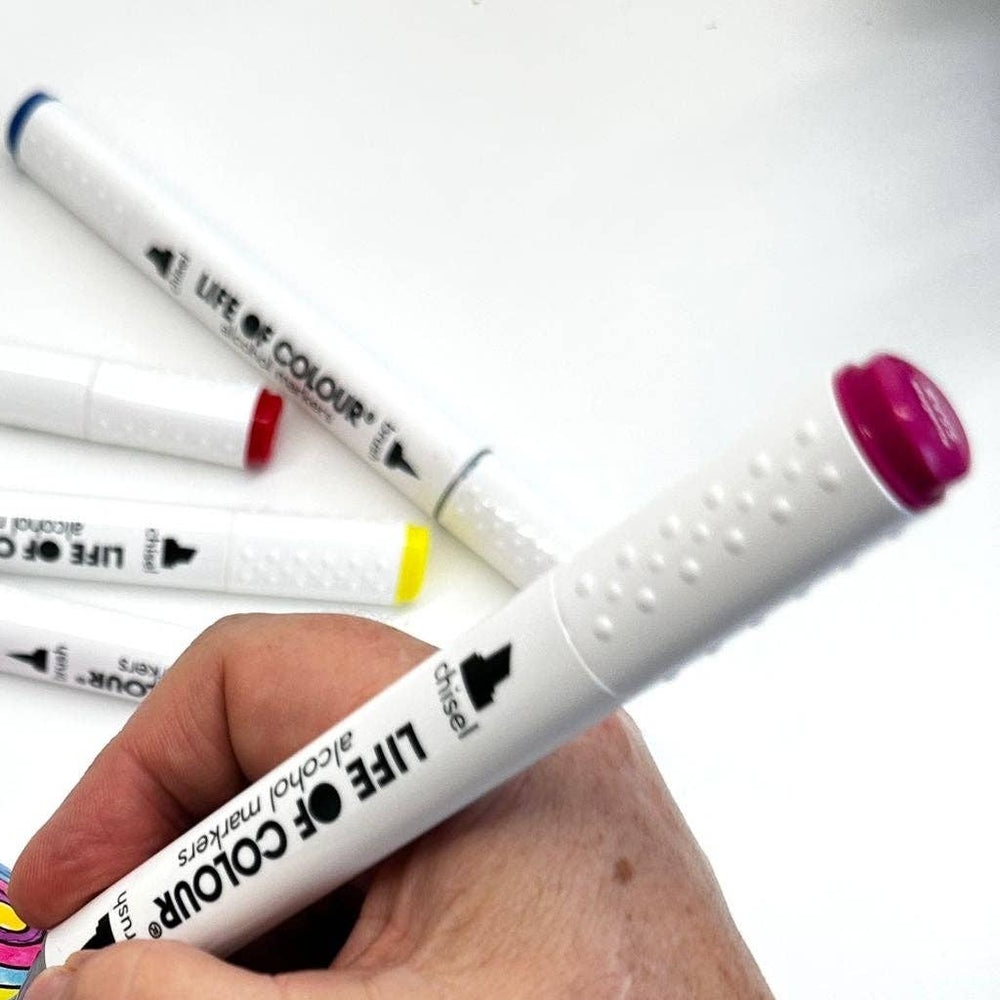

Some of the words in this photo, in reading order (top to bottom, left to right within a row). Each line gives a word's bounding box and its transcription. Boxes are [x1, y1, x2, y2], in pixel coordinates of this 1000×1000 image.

[196, 272, 239, 323] LIFE
[15, 516, 85, 536] alcohol
[70, 543, 124, 569] LIFE
[434, 662, 479, 739] chisel
[270, 731, 353, 813] alcohol
[347, 722, 427, 801] LIFE
[178, 795, 263, 867] markers
[294, 782, 342, 841] OF
[113, 890, 136, 940] rush
